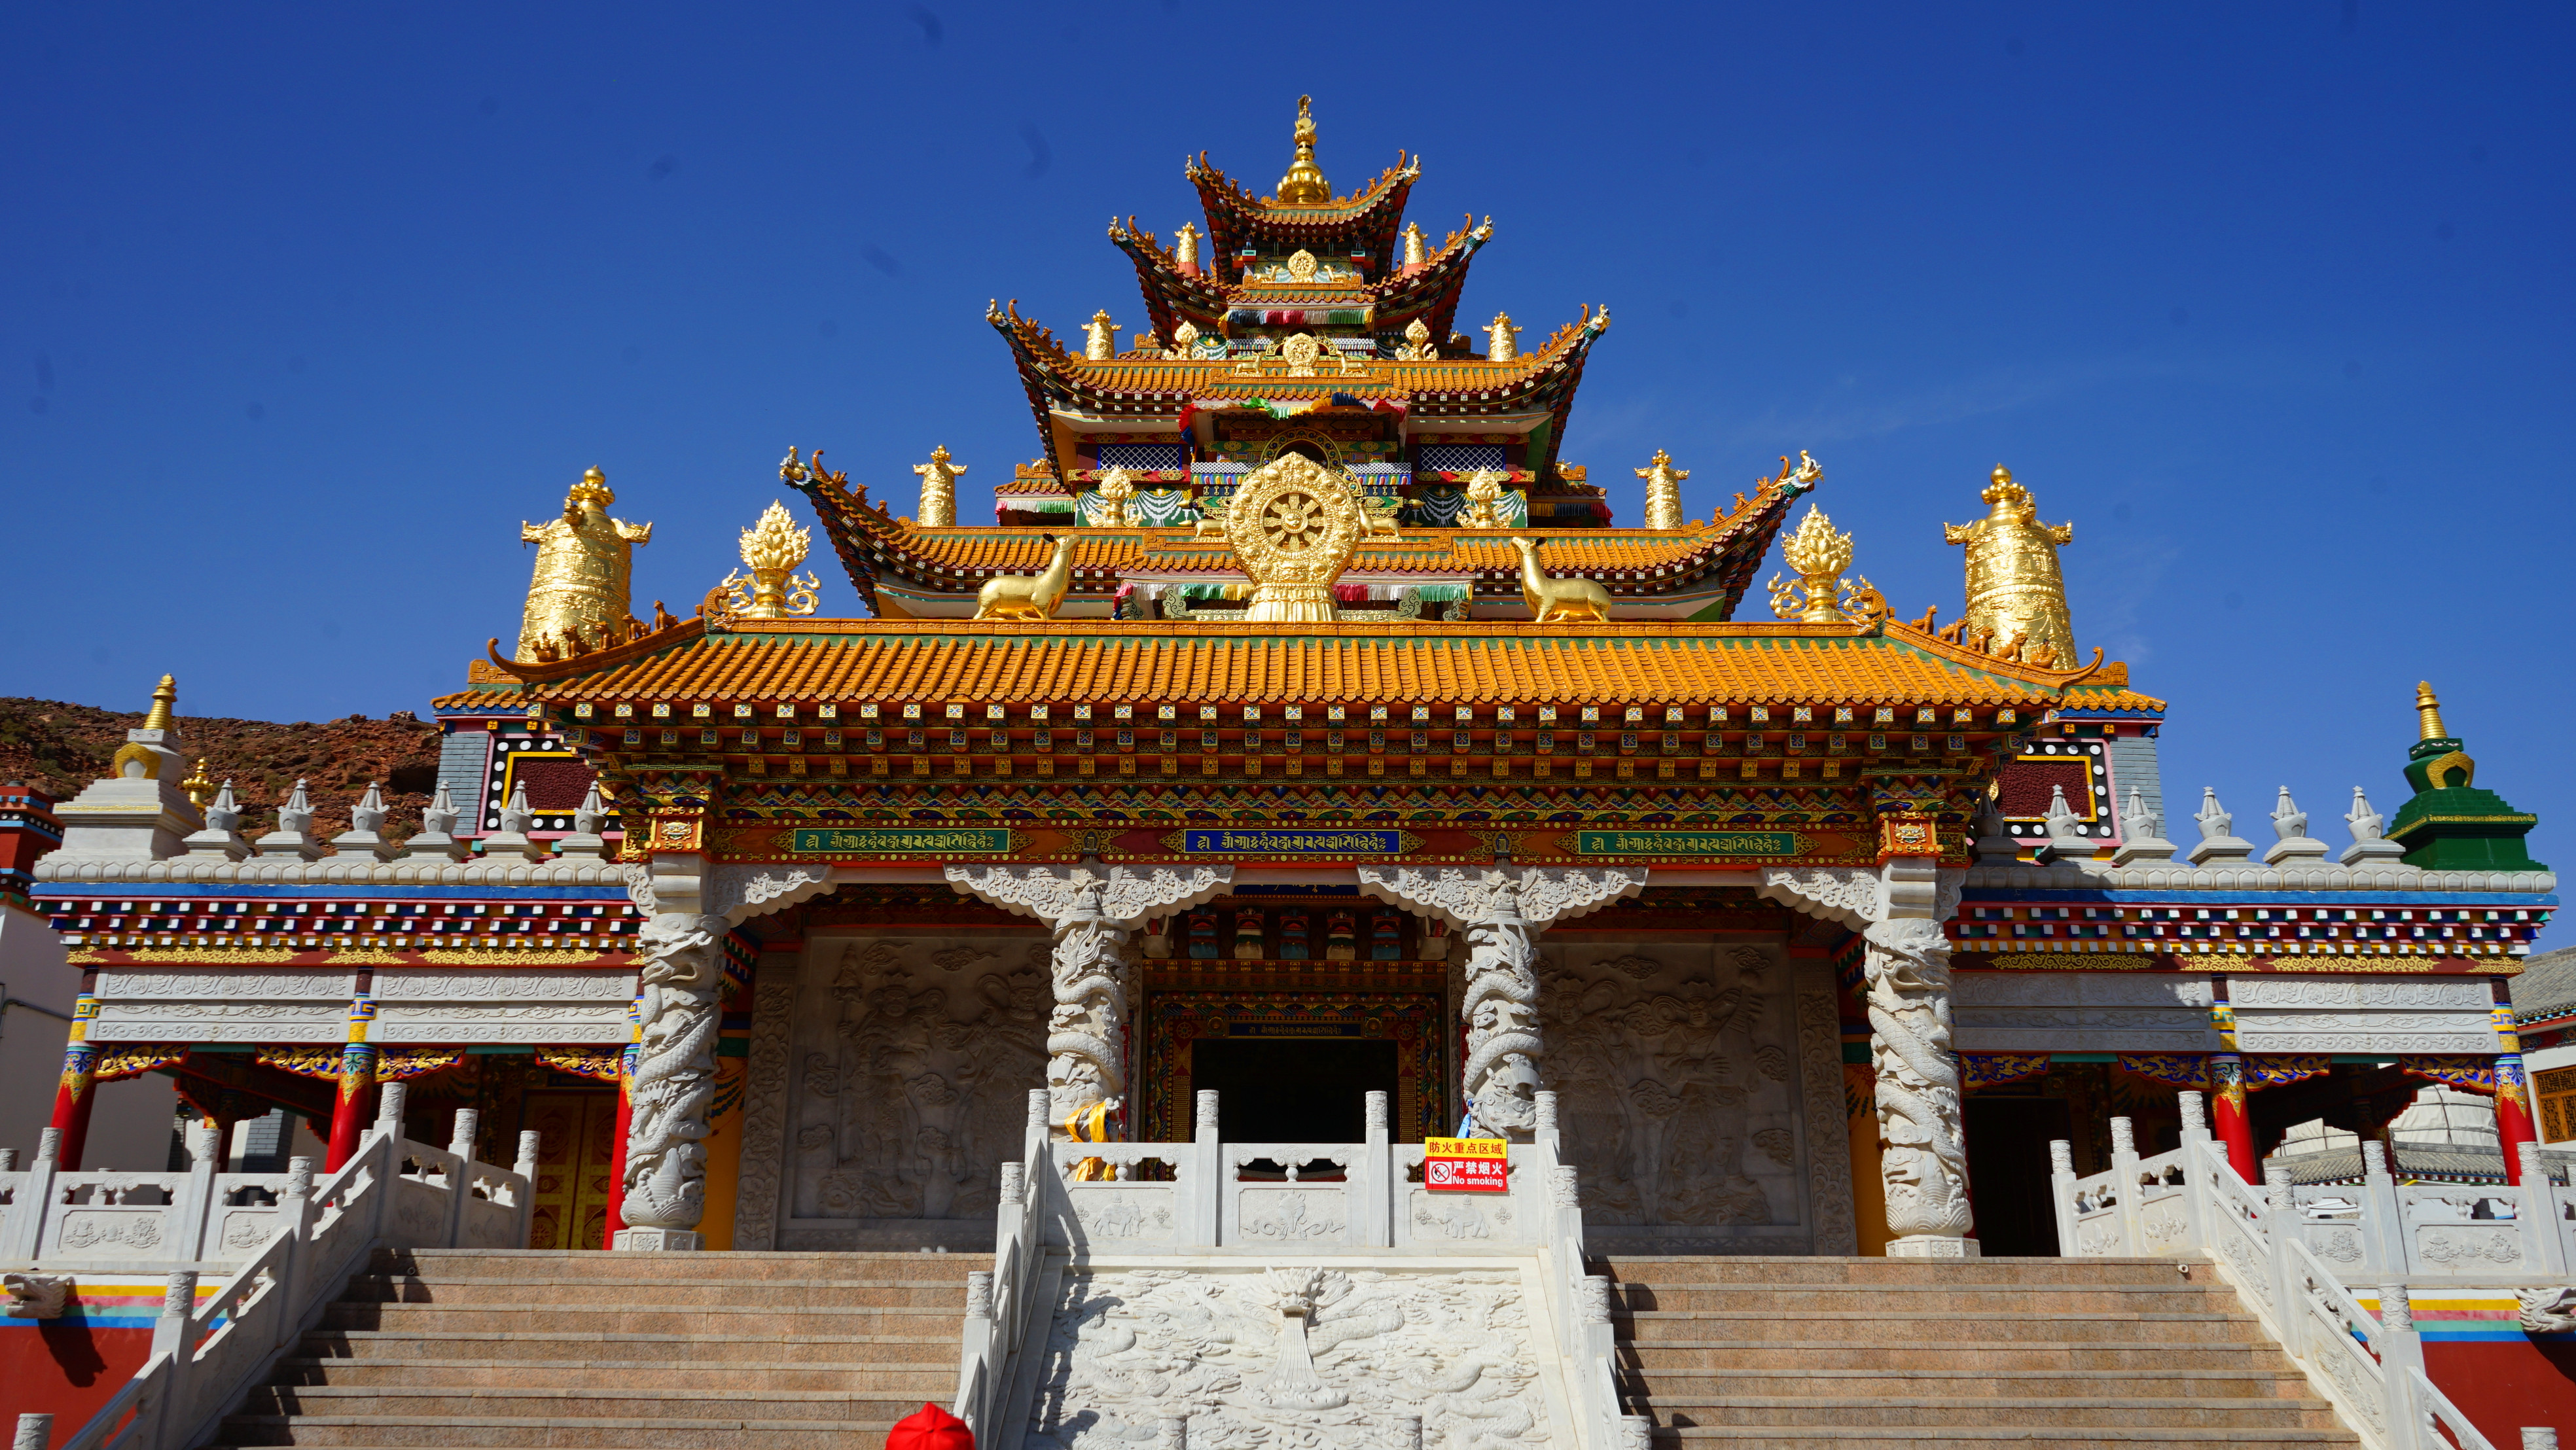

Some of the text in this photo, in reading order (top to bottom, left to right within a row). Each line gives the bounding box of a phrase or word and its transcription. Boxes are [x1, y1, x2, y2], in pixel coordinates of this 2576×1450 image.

[1429, 1141, 1503, 1155] 防火重点区域
[1452, 1161, 1503, 1176] 严禁烟火
[1452, 1175, 1503, 1188] No smoking
